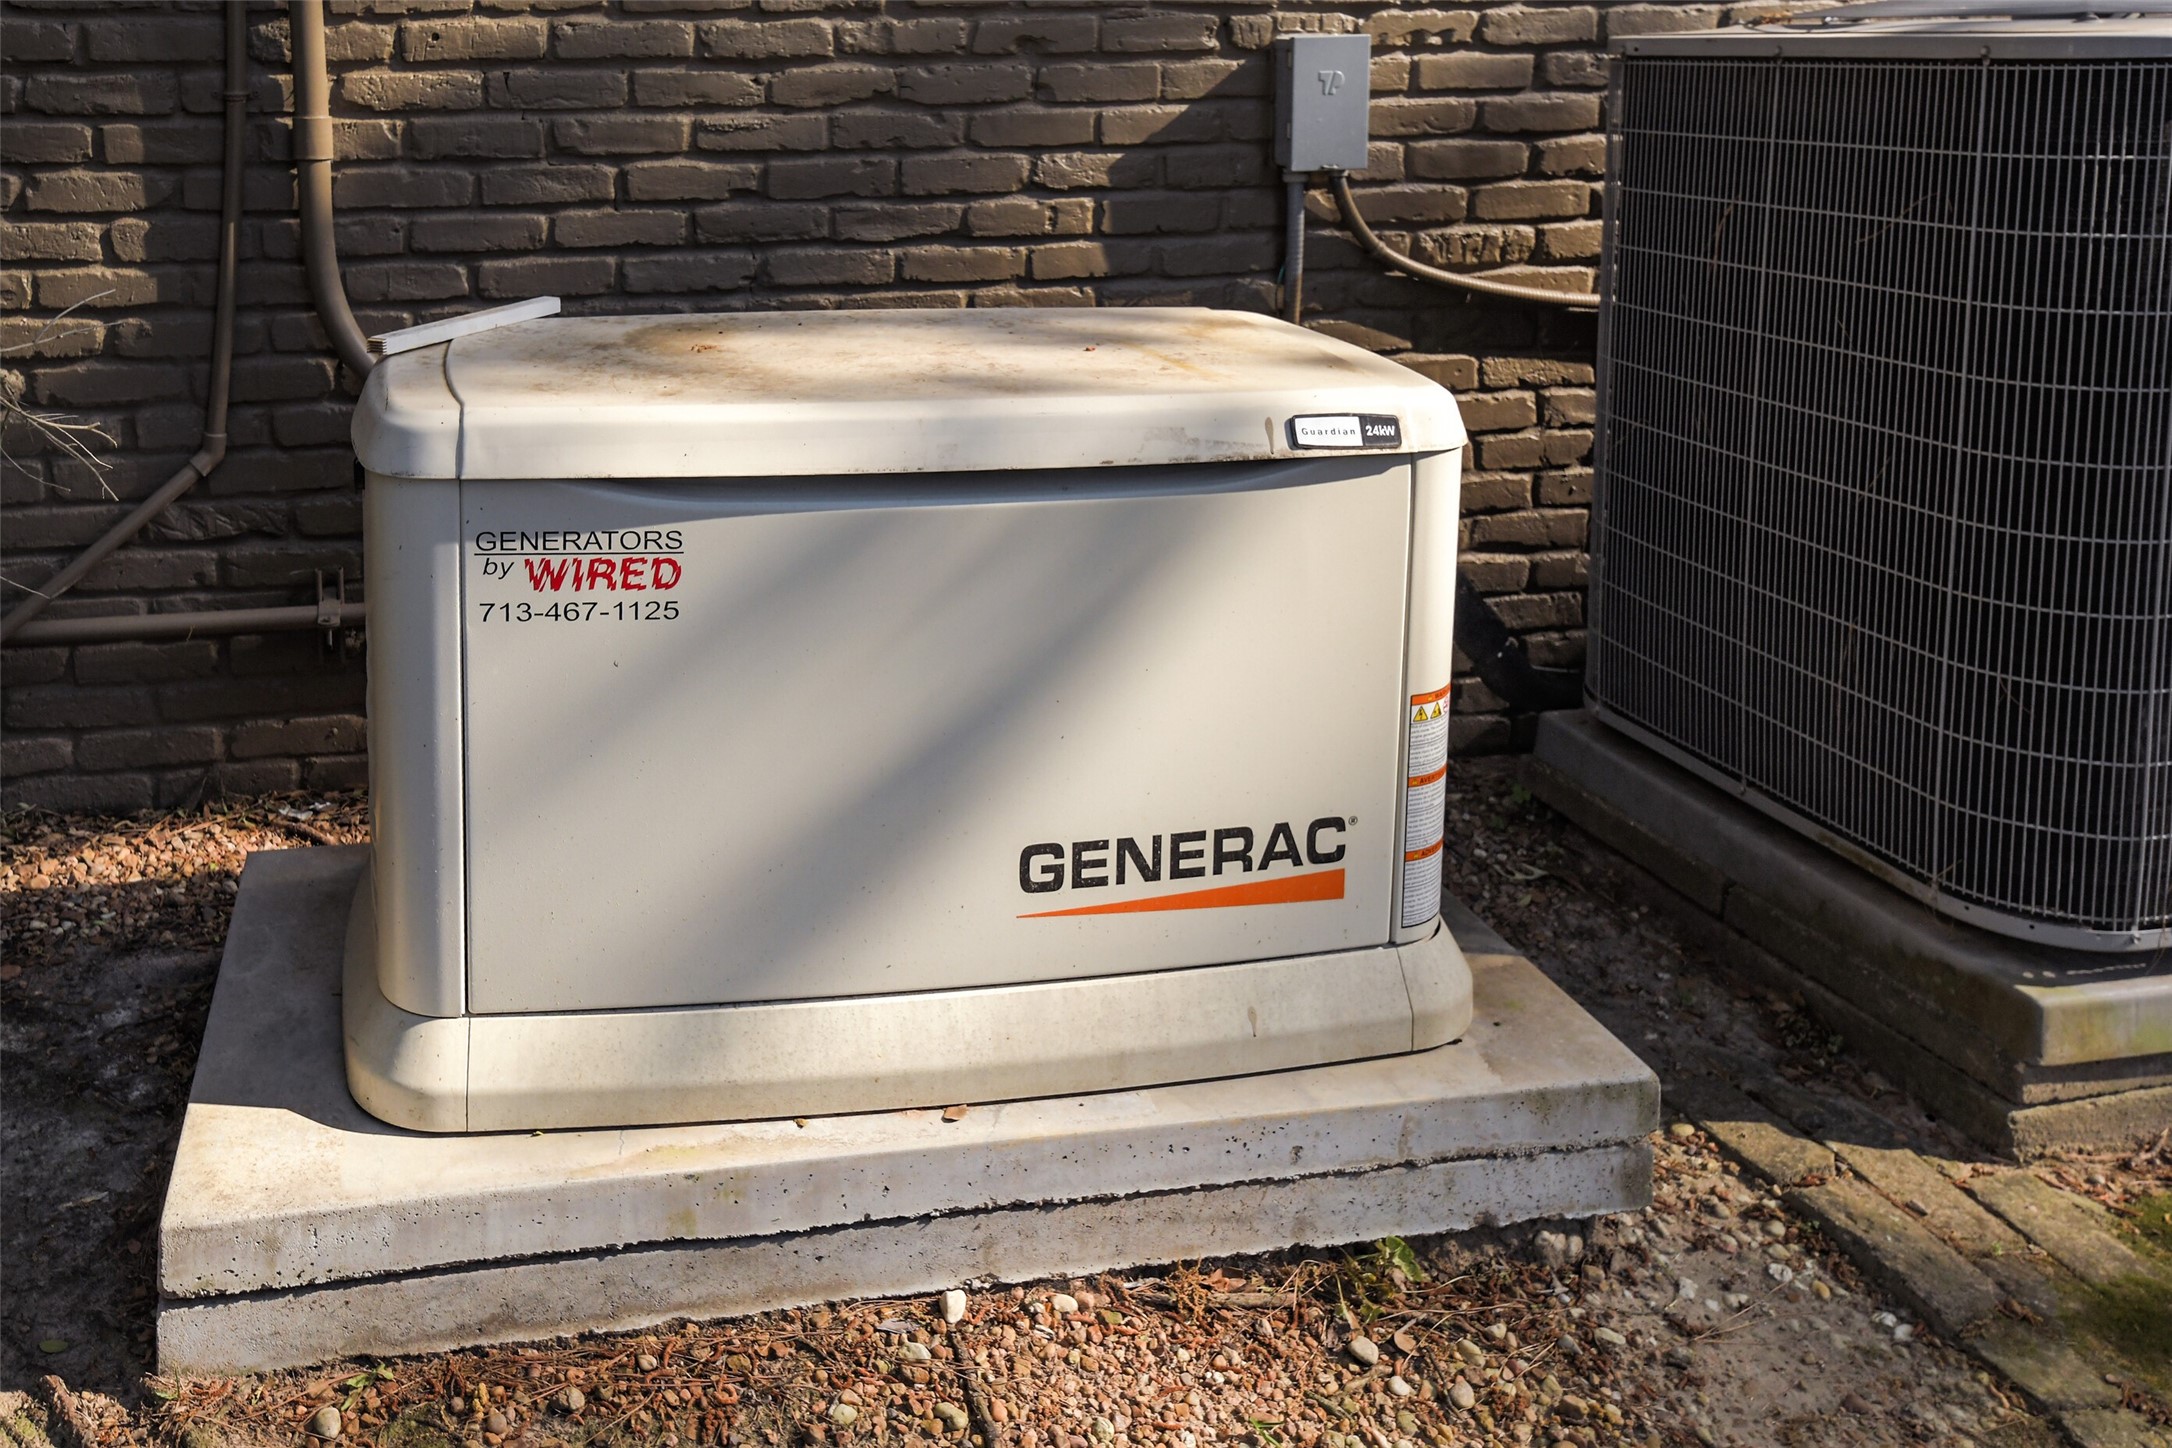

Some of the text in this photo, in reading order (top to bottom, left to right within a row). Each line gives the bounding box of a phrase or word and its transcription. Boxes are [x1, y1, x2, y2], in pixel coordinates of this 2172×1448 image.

[1301, 424, 1396, 437] Guardian 24kW
[475, 530, 683, 551] GENERATORS
[482, 557, 682, 593] by WIRED
[479, 601, 680, 622] 713-467-1125
[1019, 816, 1347, 894] GENERAC
